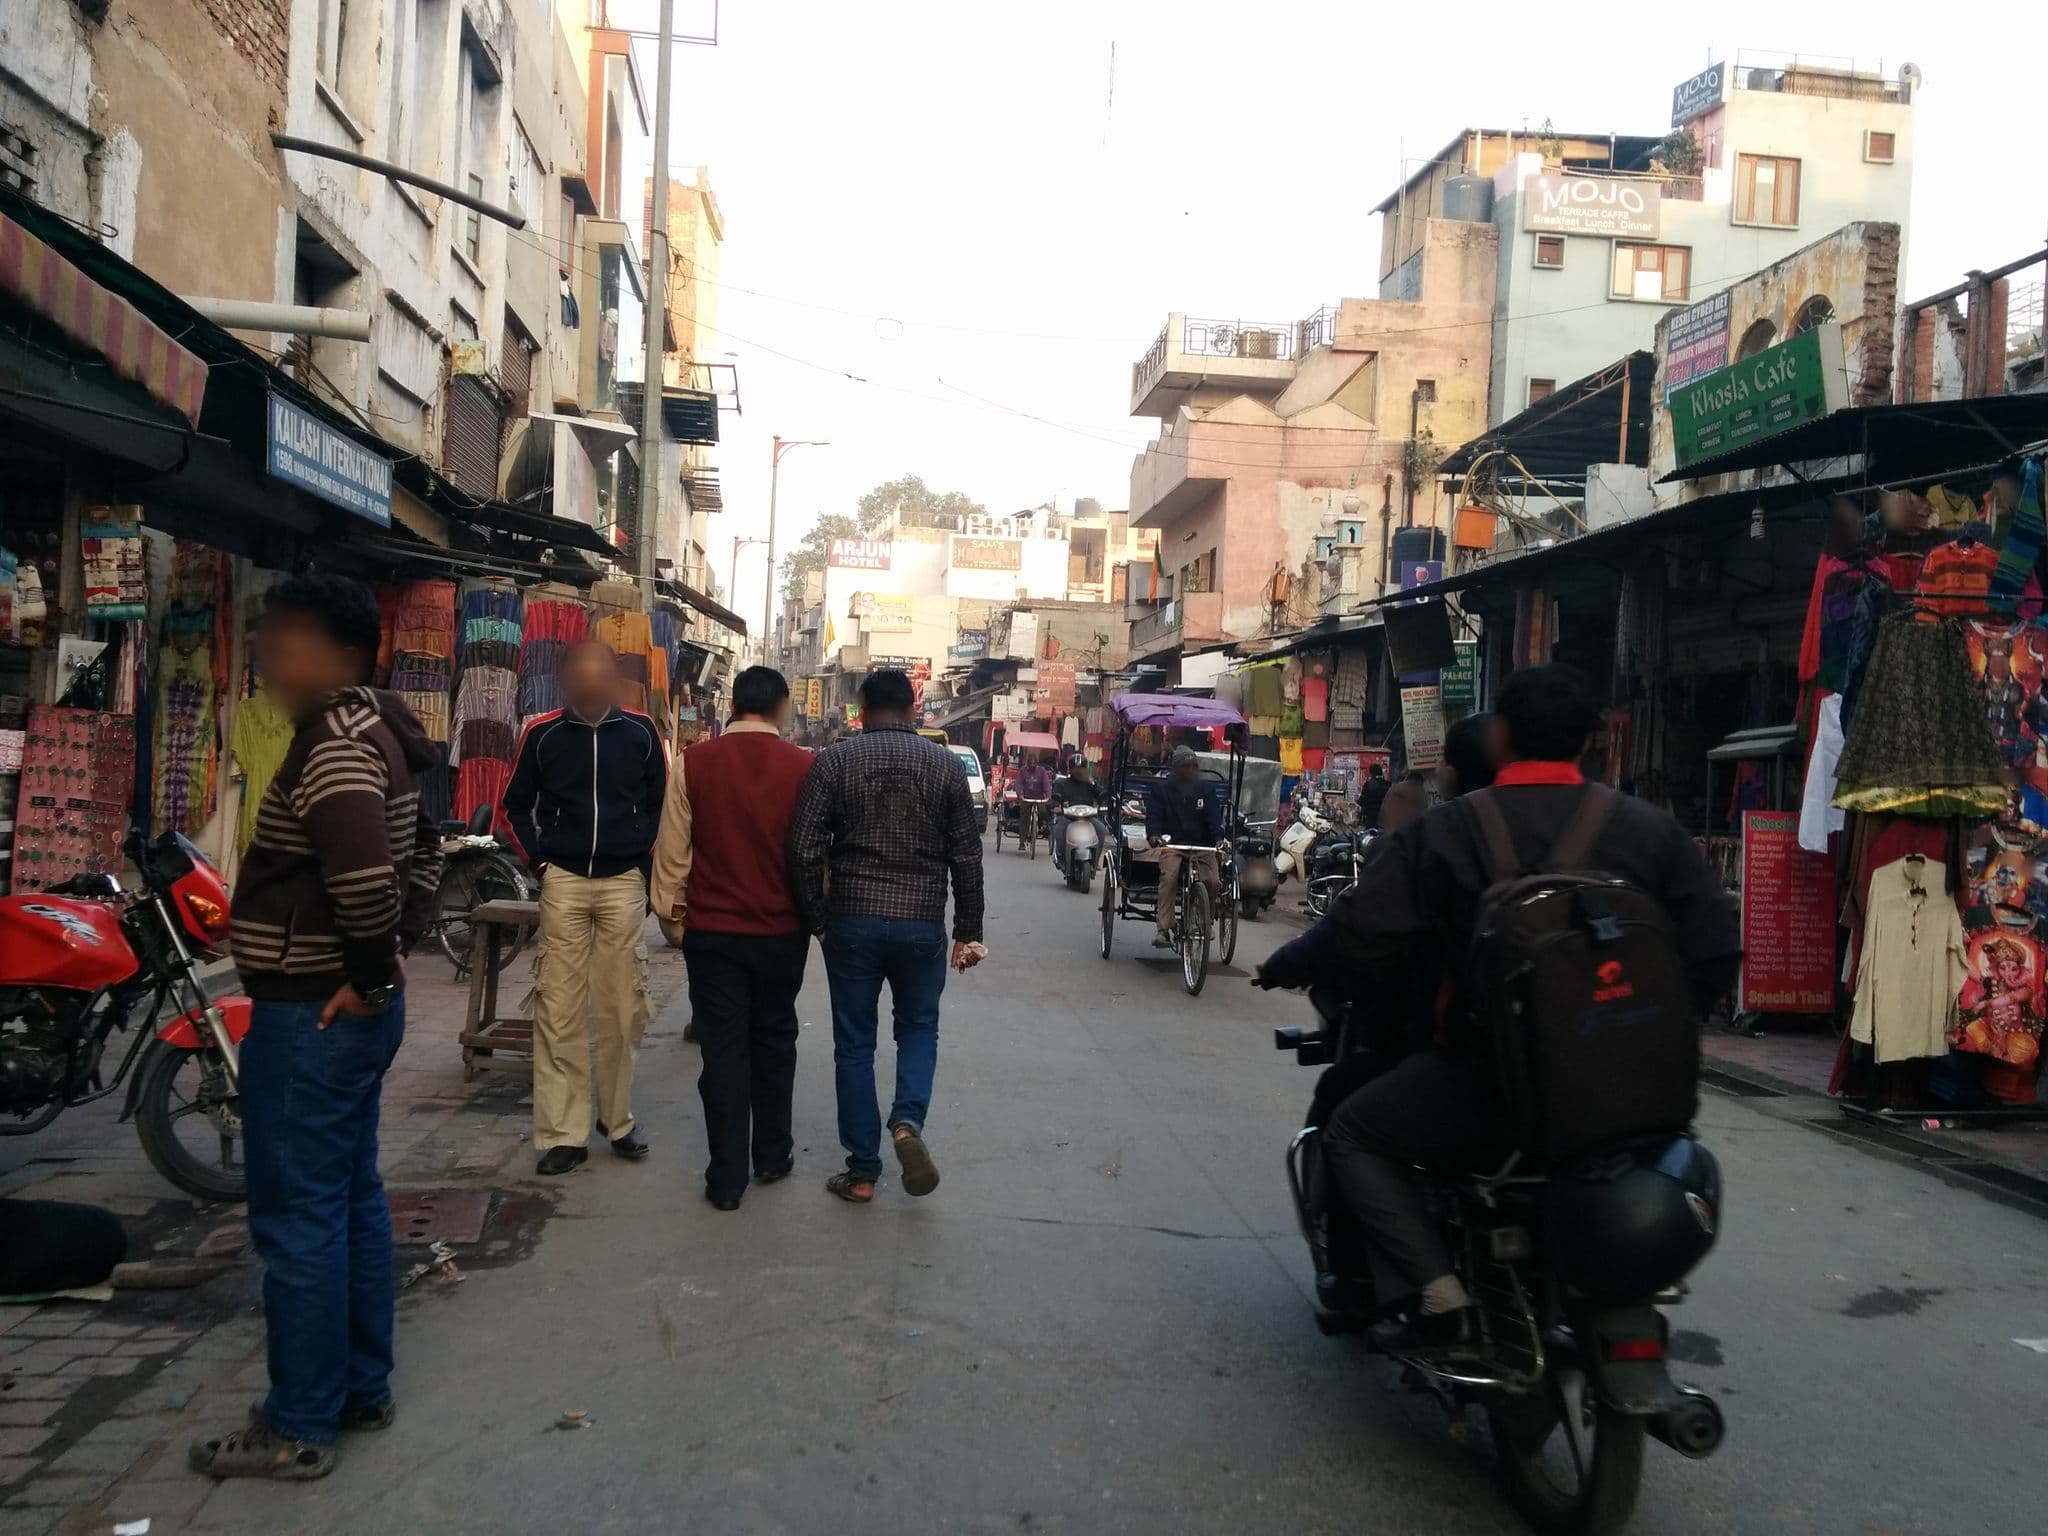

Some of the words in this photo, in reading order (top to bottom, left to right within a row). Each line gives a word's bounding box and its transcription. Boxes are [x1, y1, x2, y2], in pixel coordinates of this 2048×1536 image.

[1678, 71, 1718, 110] MOJO
[1542, 179, 1644, 213] MOJO
[1533, 213, 1580, 226] Breakfast
[1585, 219, 1615, 229] Lunch
[1620, 220, 1653, 232] Dinner
[1559, 207, 1599, 218] TERRACE
[1601, 209, 1629, 220] CAFFE
[1691, 300, 1714, 320] CYBER
[1714, 293, 1729, 312] NET
[1691, 371, 1749, 418] Khosla
[1754, 348, 1797, 392] Cafe
[1735, 408, 1753, 421] LUNCH
[1770, 393, 1791, 407] DINNER
[1701, 435, 1721, 448] CHINESE
[1773, 410, 1792, 422] INDIAN
[275, 403, 320, 462] KAILASH
[322, 430, 389, 498] INTERNATIONAL
[832, 539, 890, 558] ARJUN
[971, 540, 1005, 549] SAM'S
[839, 557, 883, 568] HOTEL
[889, 656, 903, 664] Ram
[1442, 671, 1472, 680] PALACE
[810, 680, 818, 715] ARJUN
[1748, 990, 1796, 1007] Special
[1799, 990, 1831, 1005] Thali
